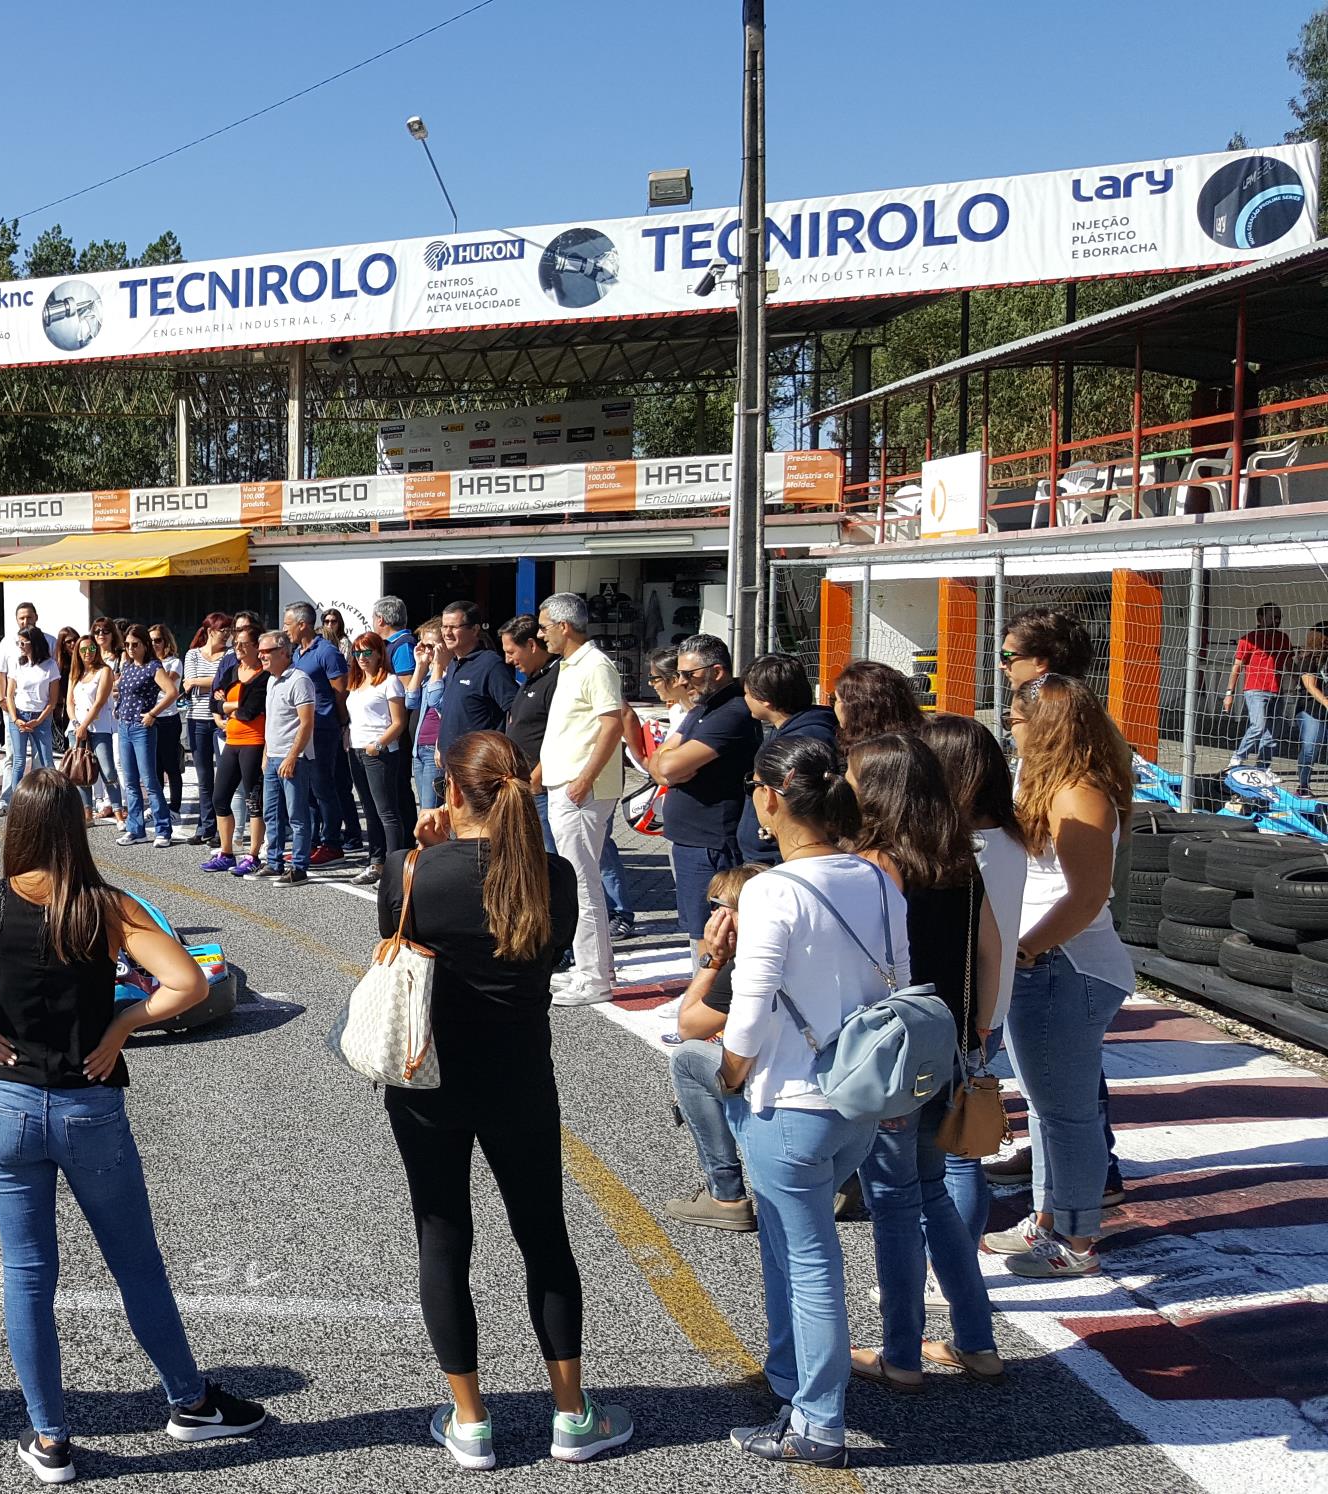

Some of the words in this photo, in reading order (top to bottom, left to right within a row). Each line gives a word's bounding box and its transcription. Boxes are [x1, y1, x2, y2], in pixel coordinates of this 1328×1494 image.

[1072, 215, 1130, 231] INJEÇÃO
[641, 192, 1010, 273] TECNIROLO
[1072, 230, 1136, 246] PLÁSTICO
[458, 241, 520, 263] HURON
[1072, 248, 1079, 259] E
[1082, 241, 1158, 259] BORRACHA
[118, 252, 397, 319] TECNIROLO
[427, 277, 474, 290] CENTROS
[427, 286, 498, 302] MAQUINAÇÃO
[426, 303, 452, 314] ALTA
[455, 298, 521, 312] VELOCIDADE
[153, 322, 233, 339] ENGENHARIA
[786, 454, 822, 462] Precisão
[587, 464, 605, 472] Mais
[786, 472, 822, 480] Indústria
[458, 473, 545, 496] HASCO
[785, 481, 817, 489] Moldes.
[289, 483, 368, 505] HASCO
[405, 490, 435, 499] Indústria
[644, 492, 696, 505] Enabling
[699, 490, 723, 501] with
[136, 492, 208, 513] HASCO
[457, 501, 505, 514] Enabling
[508, 500, 530, 511] with
[288, 510, 332, 521] Enabling
[334, 509, 355, 519] with
[1241, 772, 1262, 786] 26
